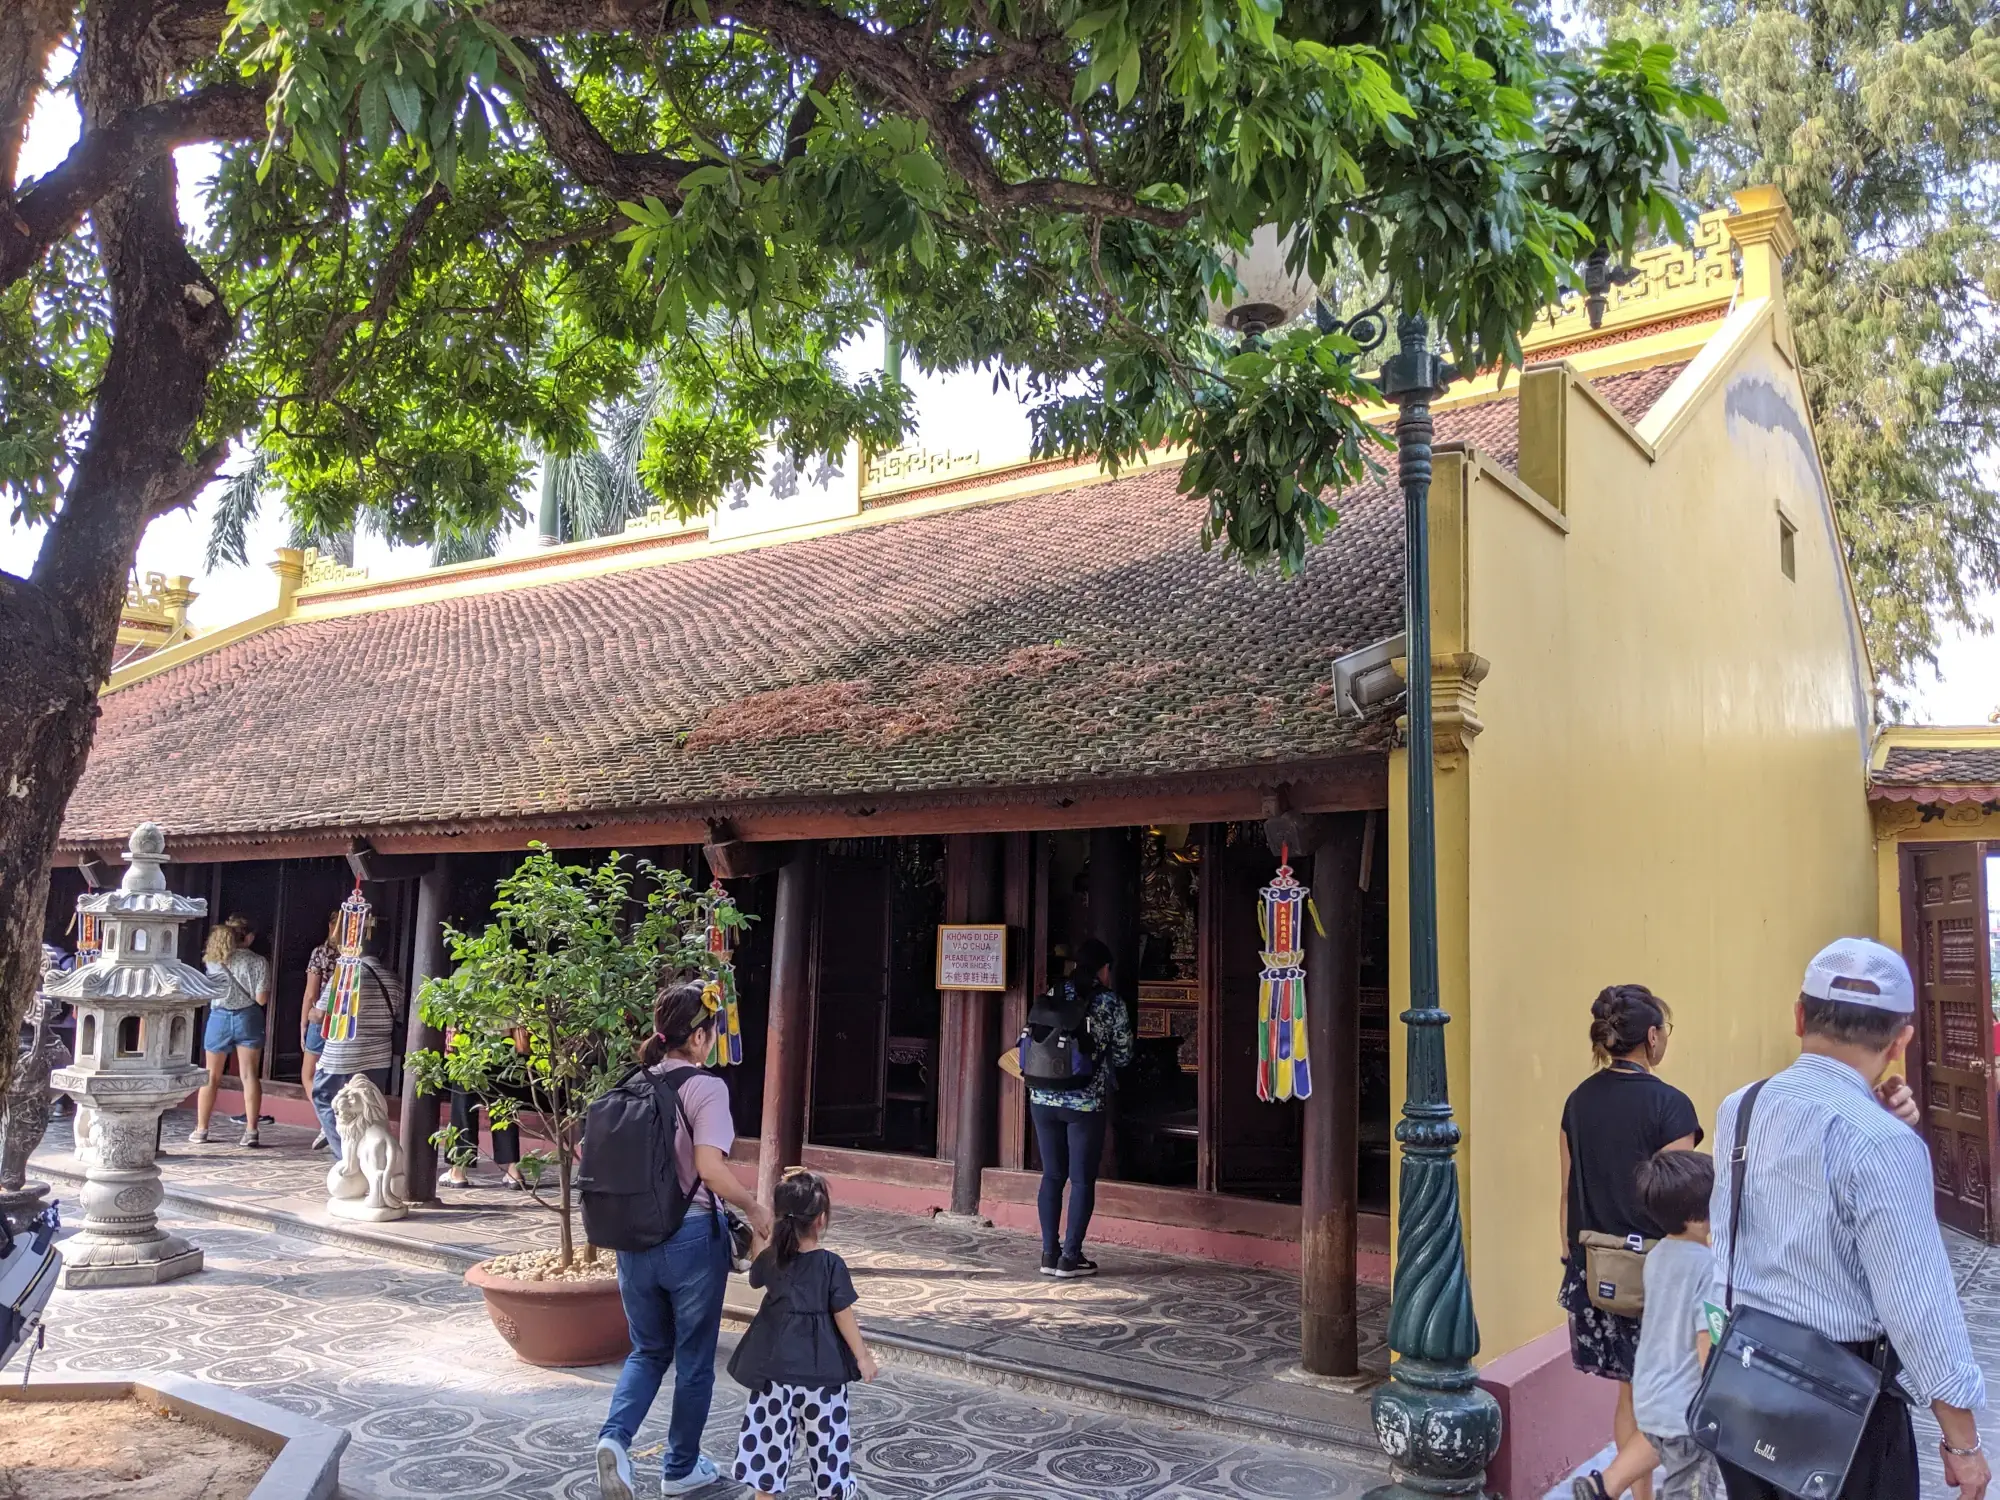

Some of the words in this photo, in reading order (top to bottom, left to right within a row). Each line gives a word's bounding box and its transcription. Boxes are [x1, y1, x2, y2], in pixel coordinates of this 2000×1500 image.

[946, 932, 973, 941] KHÔNG
[944, 954, 969, 962] PLEASE
[969, 954, 985, 962] TAKE
[986, 955, 1000, 963] OFF
[969, 962, 992, 970] SHOES
[945, 971, 999, 984] 不能穿鞋进去
